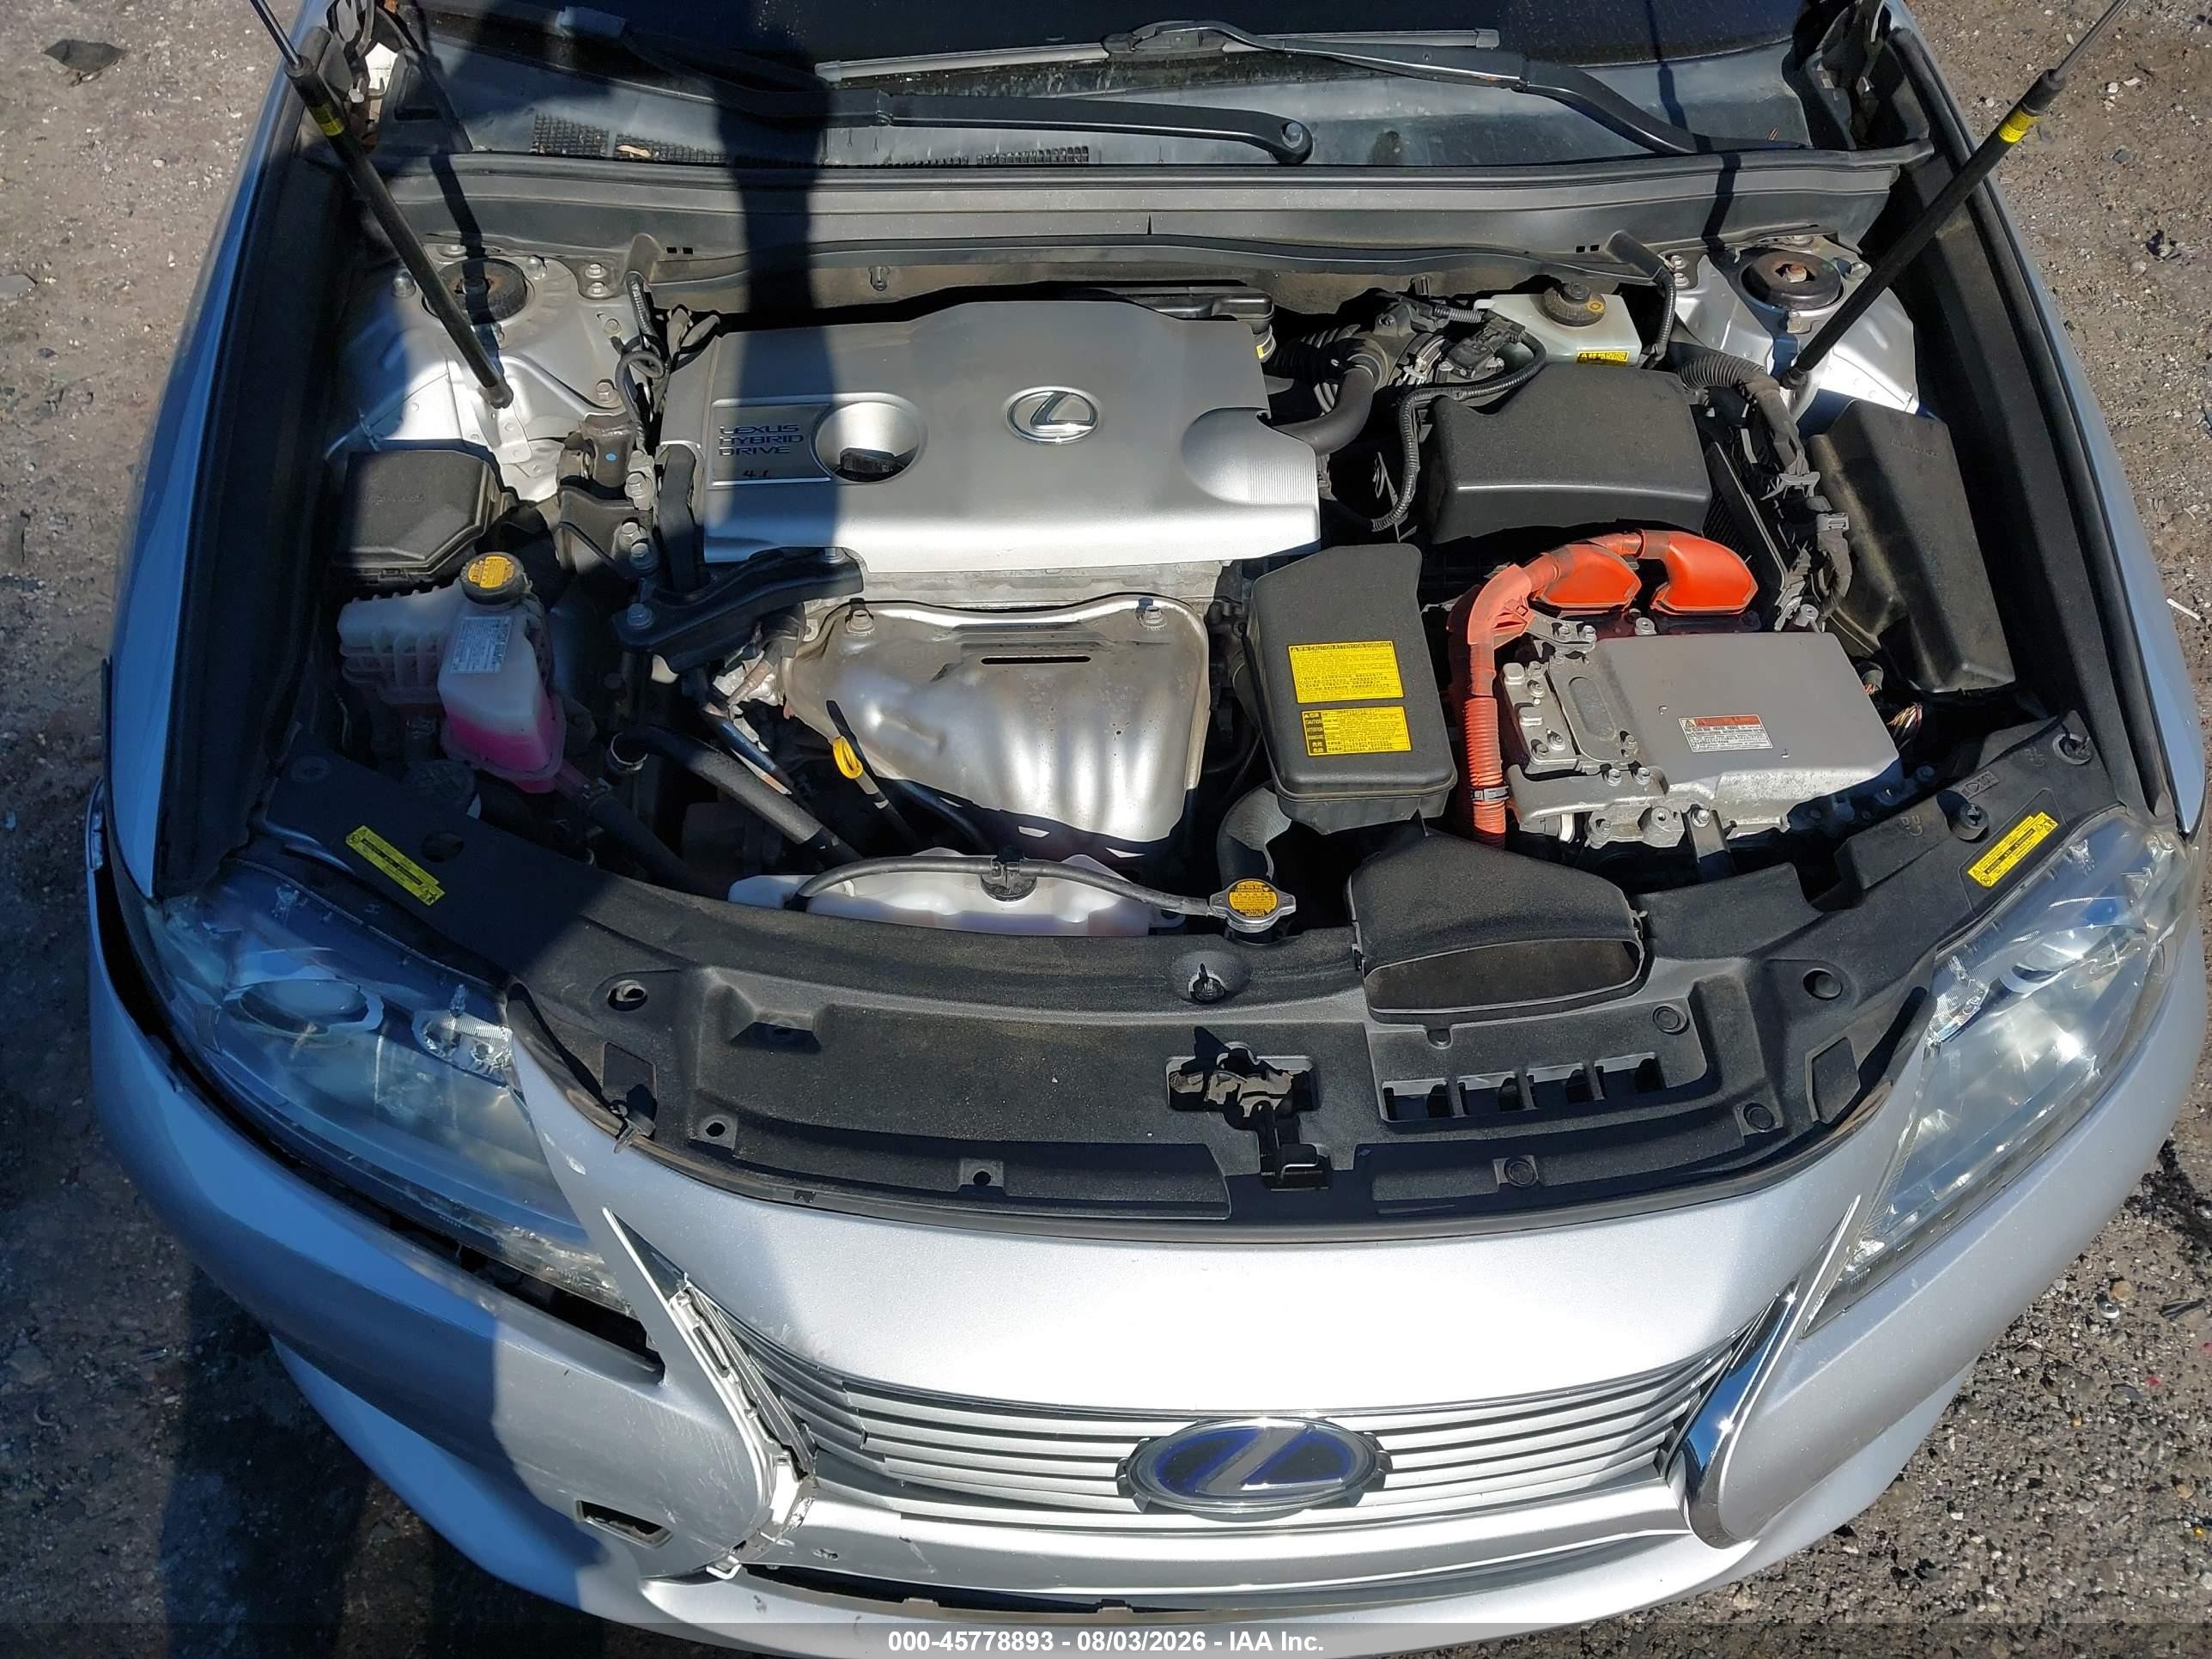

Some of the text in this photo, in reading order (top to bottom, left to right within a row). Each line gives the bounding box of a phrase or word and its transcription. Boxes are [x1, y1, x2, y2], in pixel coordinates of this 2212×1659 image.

[720, 424, 799, 434] LEXUS
[719, 435, 804, 444] HYBRID
[719, 447, 790, 456] DRIVE
